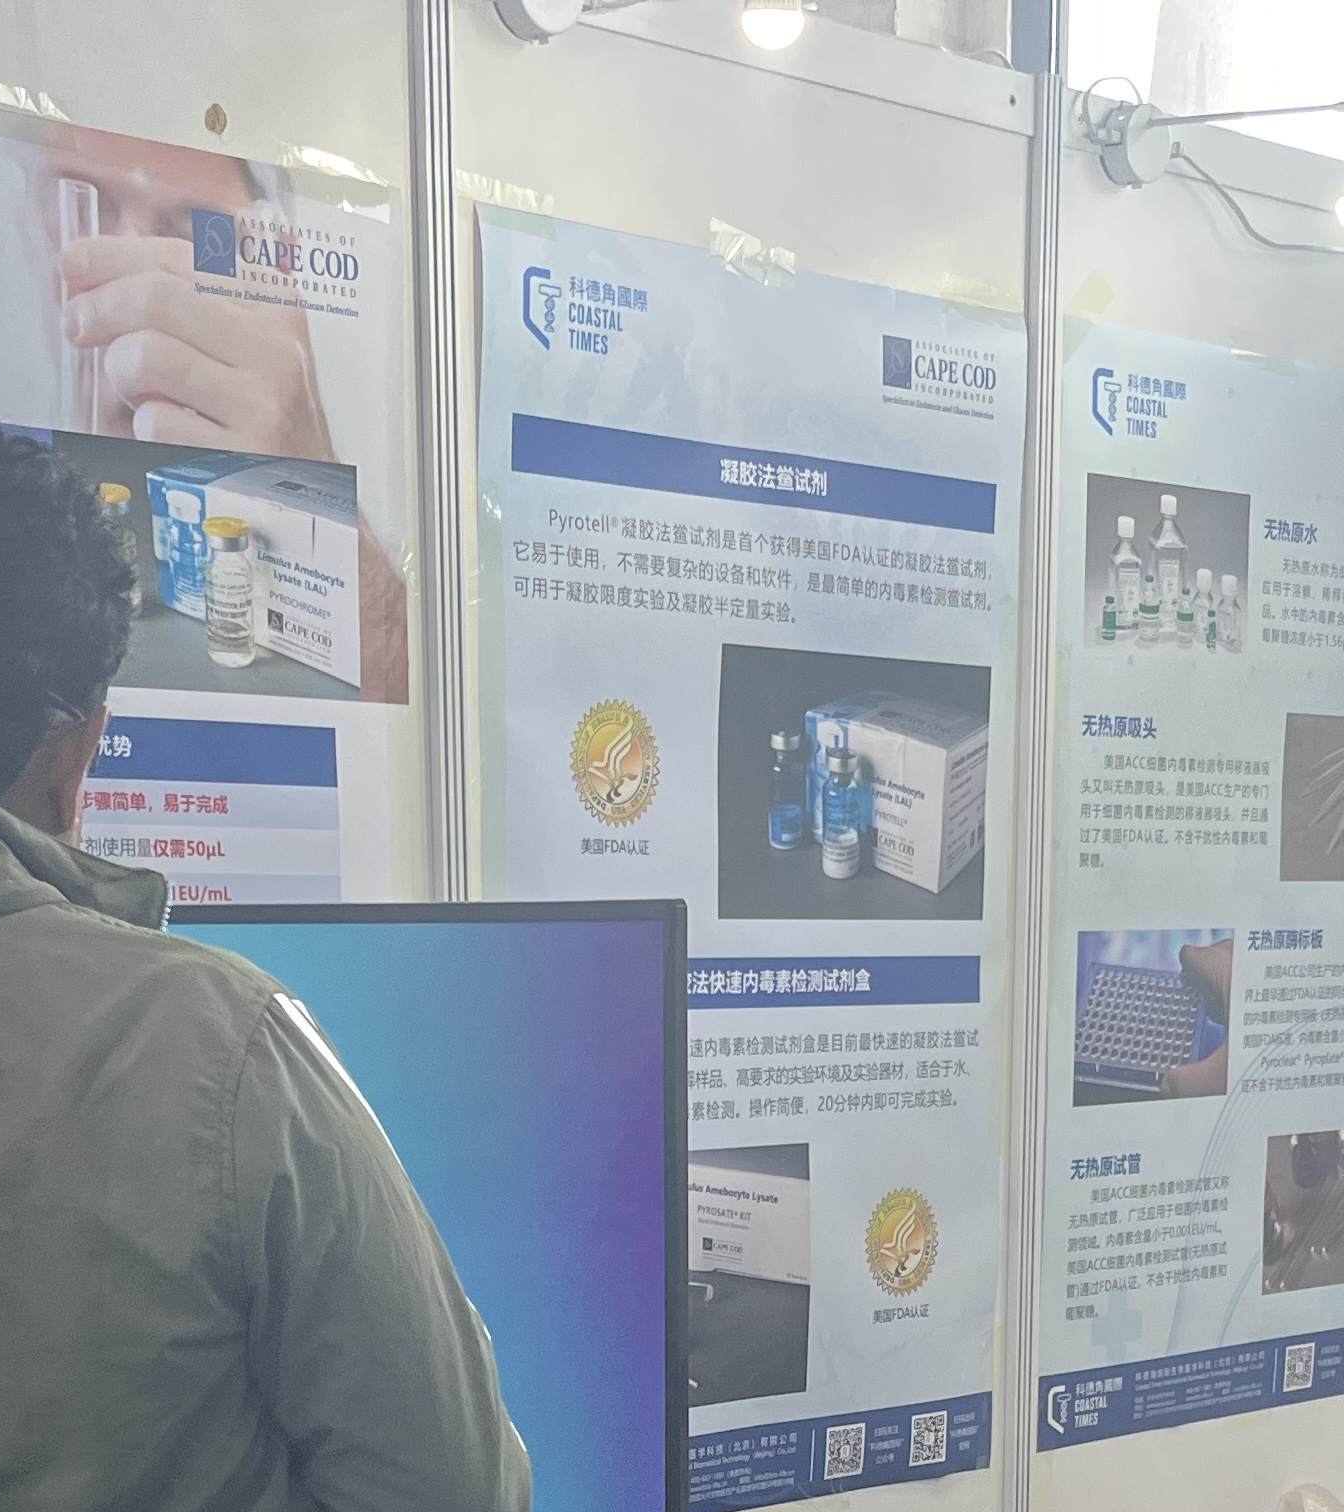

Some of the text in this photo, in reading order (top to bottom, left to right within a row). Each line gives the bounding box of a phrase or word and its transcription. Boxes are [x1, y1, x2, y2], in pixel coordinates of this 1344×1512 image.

[240, 235, 359, 281] CAPE COD
[242, 270, 357, 298] INCORPORATED
[569, 276, 648, 312] 科德角國際
[569, 302, 623, 332] COASTAL
[569, 329, 608, 355] TIMES
[915, 354, 996, 390] CAPE COD
[1126, 396, 1168, 418] COASTAL
[1126, 418, 1157, 438] TIMES
[720, 458, 828, 496] 凝胶法鲎试剂
[1264, 518, 1318, 544] 无热原水
[1081, 714, 1157, 739] 无热原吸头
[581, 837, 650, 855] 美国FDA认证
[1070, 1153, 1141, 1180] 无热原试管
[1074, 1395, 1108, 1413] COASTAL
[1074, 1413, 1099, 1428] TIMES
